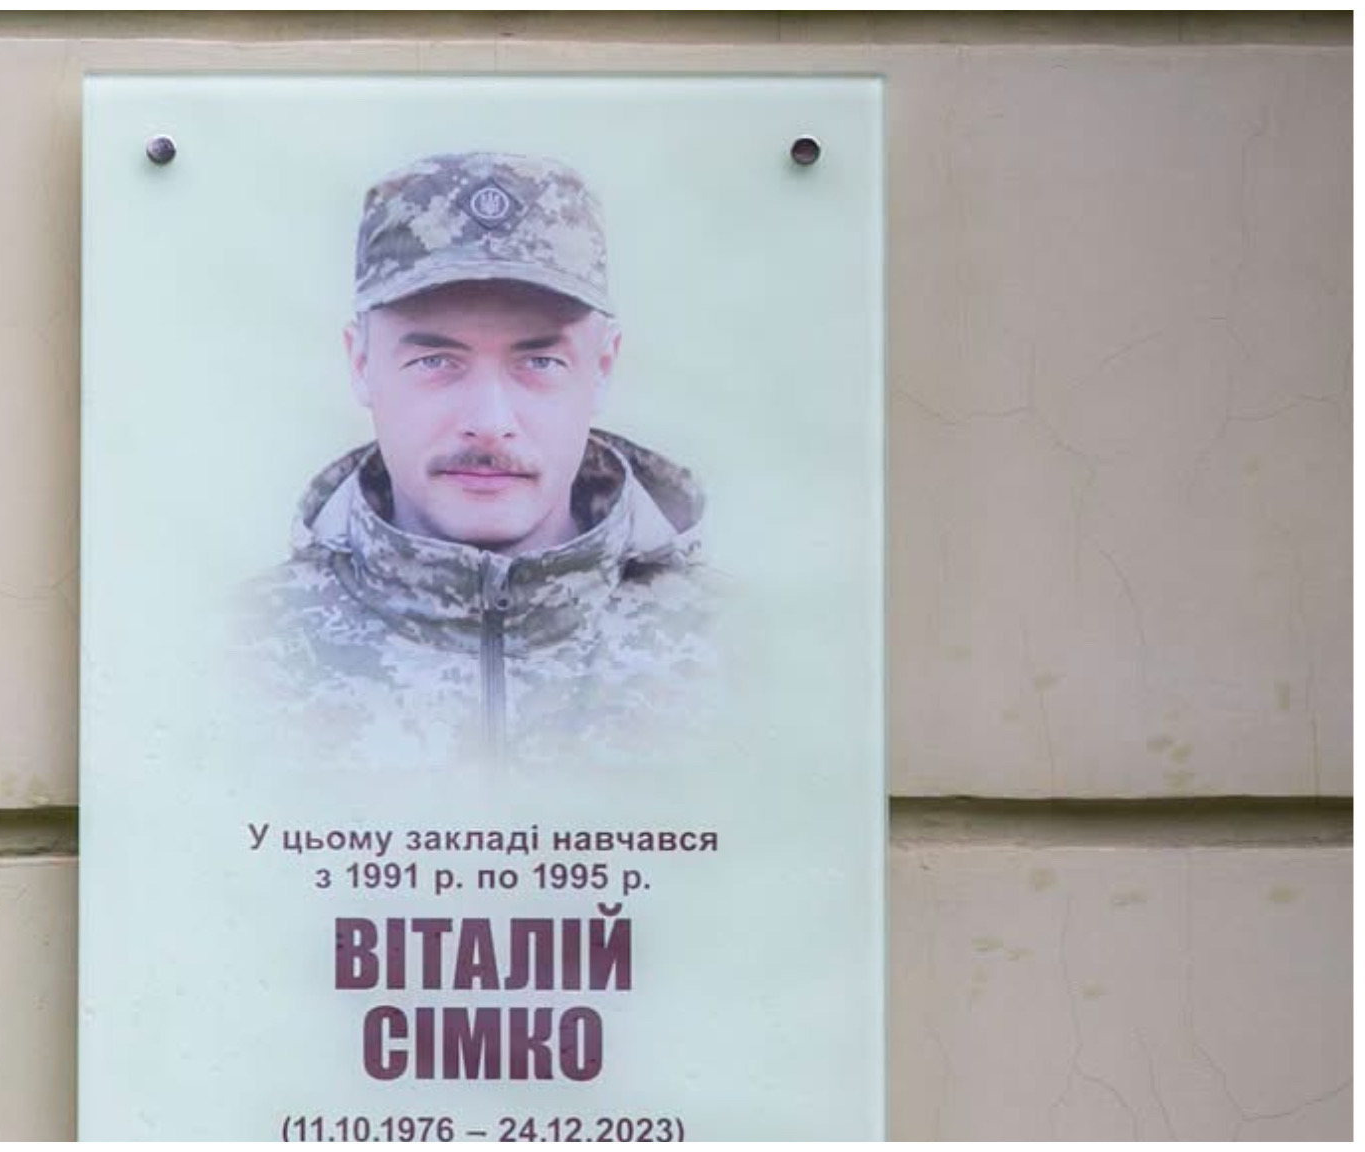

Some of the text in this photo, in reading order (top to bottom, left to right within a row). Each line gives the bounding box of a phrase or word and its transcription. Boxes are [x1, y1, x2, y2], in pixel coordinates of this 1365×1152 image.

[248, 823, 718, 858] У цьому закладі навчався
[315, 862, 651, 897] з 1991 р. по 1995 р.
[334, 902, 632, 991] ВІТАЛІЙ
[363, 1005, 603, 1082] СІМКО
[282, 1115, 455, 1142] (11.10.1976
[498, 1116, 685, 1142] 24.12.2023)
